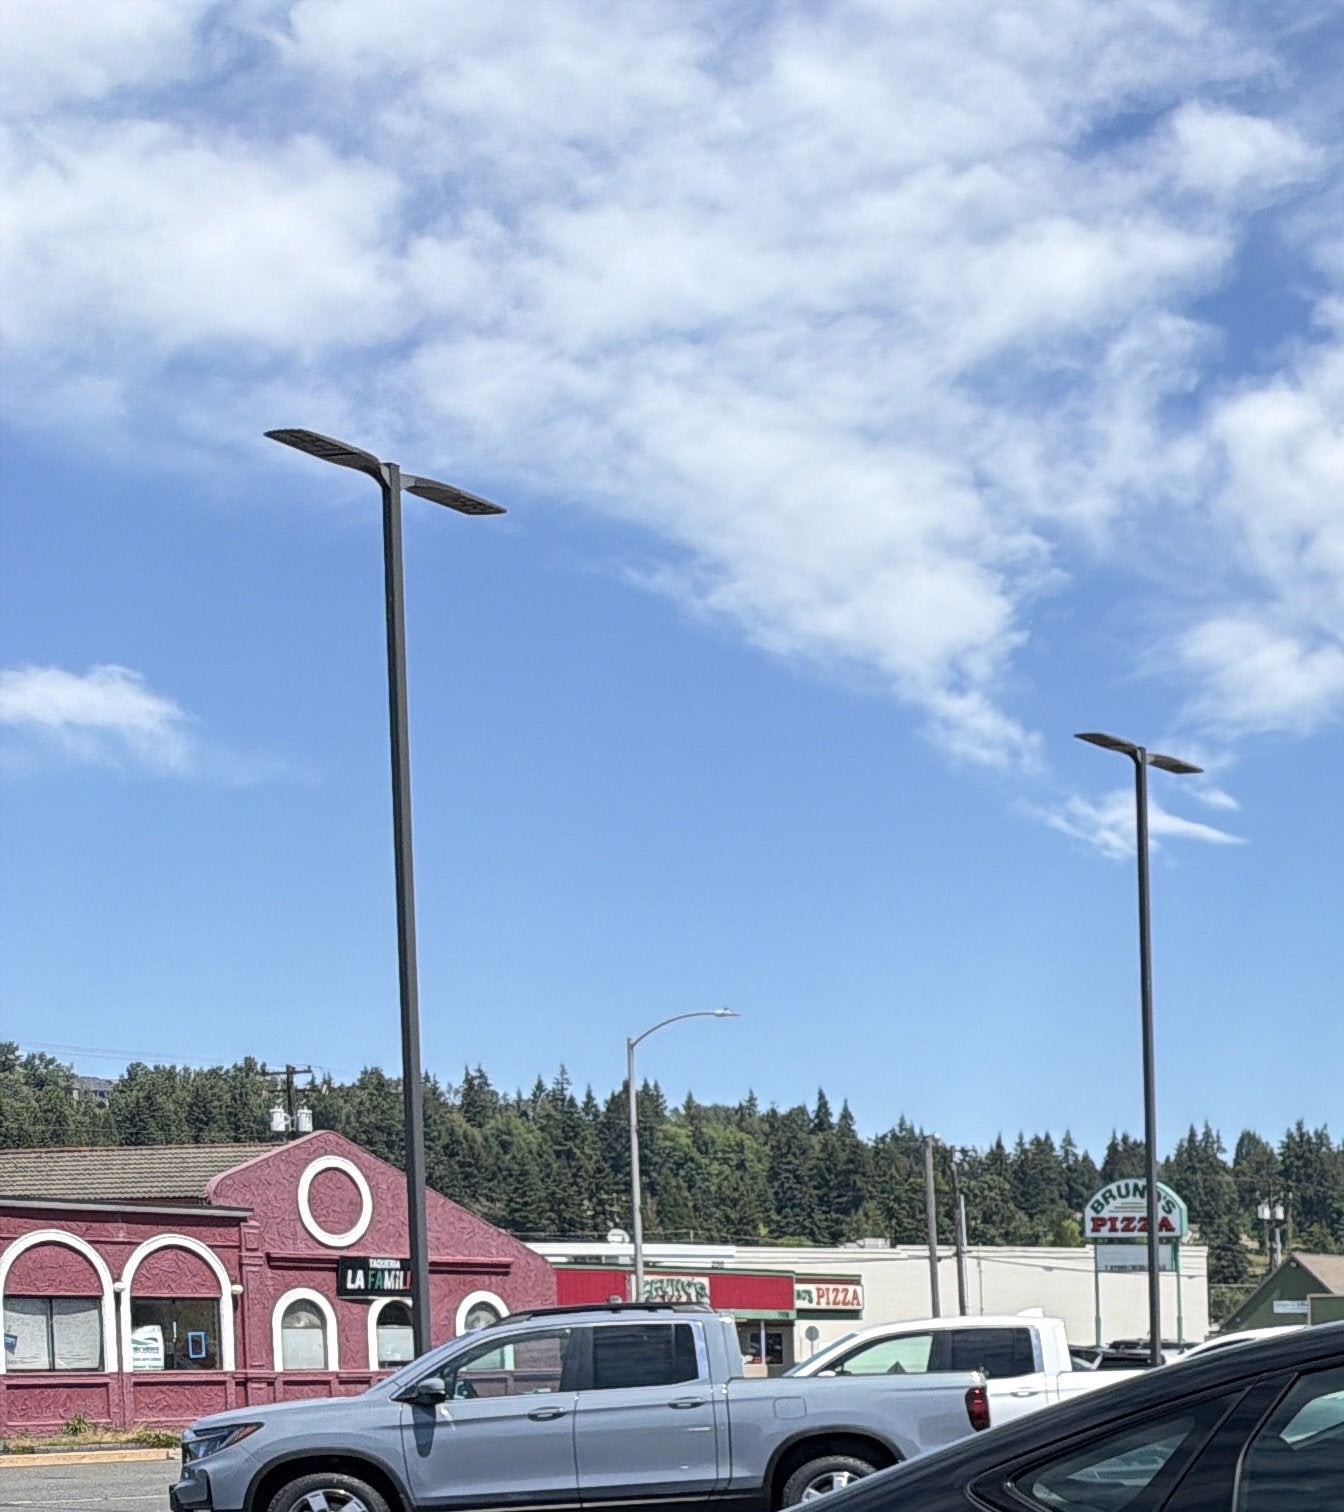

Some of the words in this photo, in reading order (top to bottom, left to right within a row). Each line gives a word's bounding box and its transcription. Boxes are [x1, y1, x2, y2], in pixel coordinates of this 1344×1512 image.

[1090, 1182, 1177, 1215] BRUN'S
[346, 1269, 366, 1289] LA
[367, 1270, 413, 1290] FAMILI
[815, 1287, 861, 1306] PIZZA
